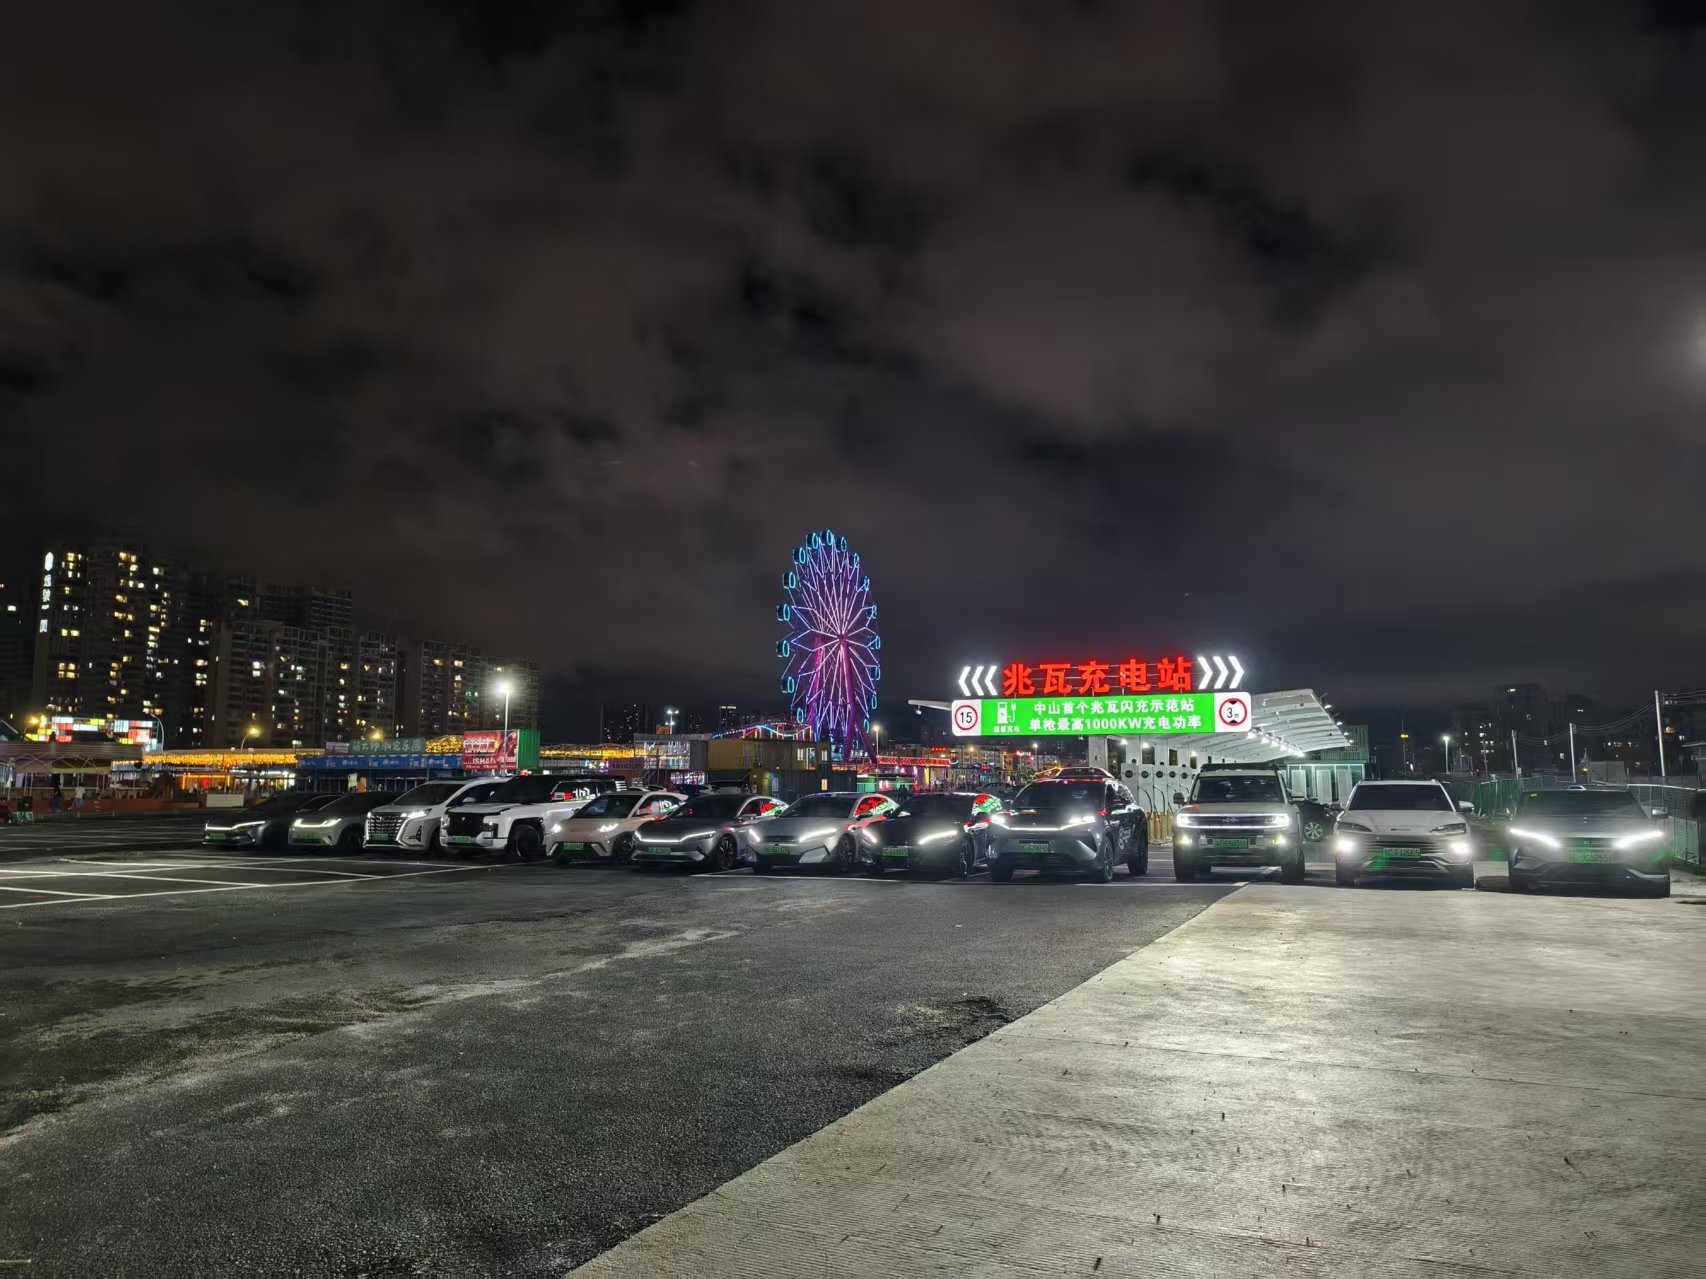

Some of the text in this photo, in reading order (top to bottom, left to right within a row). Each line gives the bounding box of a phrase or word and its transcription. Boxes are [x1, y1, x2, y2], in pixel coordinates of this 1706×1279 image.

[1003, 656, 1192, 697] 兆瓦充电站
[1033, 698, 1194, 715] 中山首个兆瓦闪充示范站
[960, 711, 973, 724] 15
[1029, 715, 1202, 731] 单枪最高1000KW充电功率
